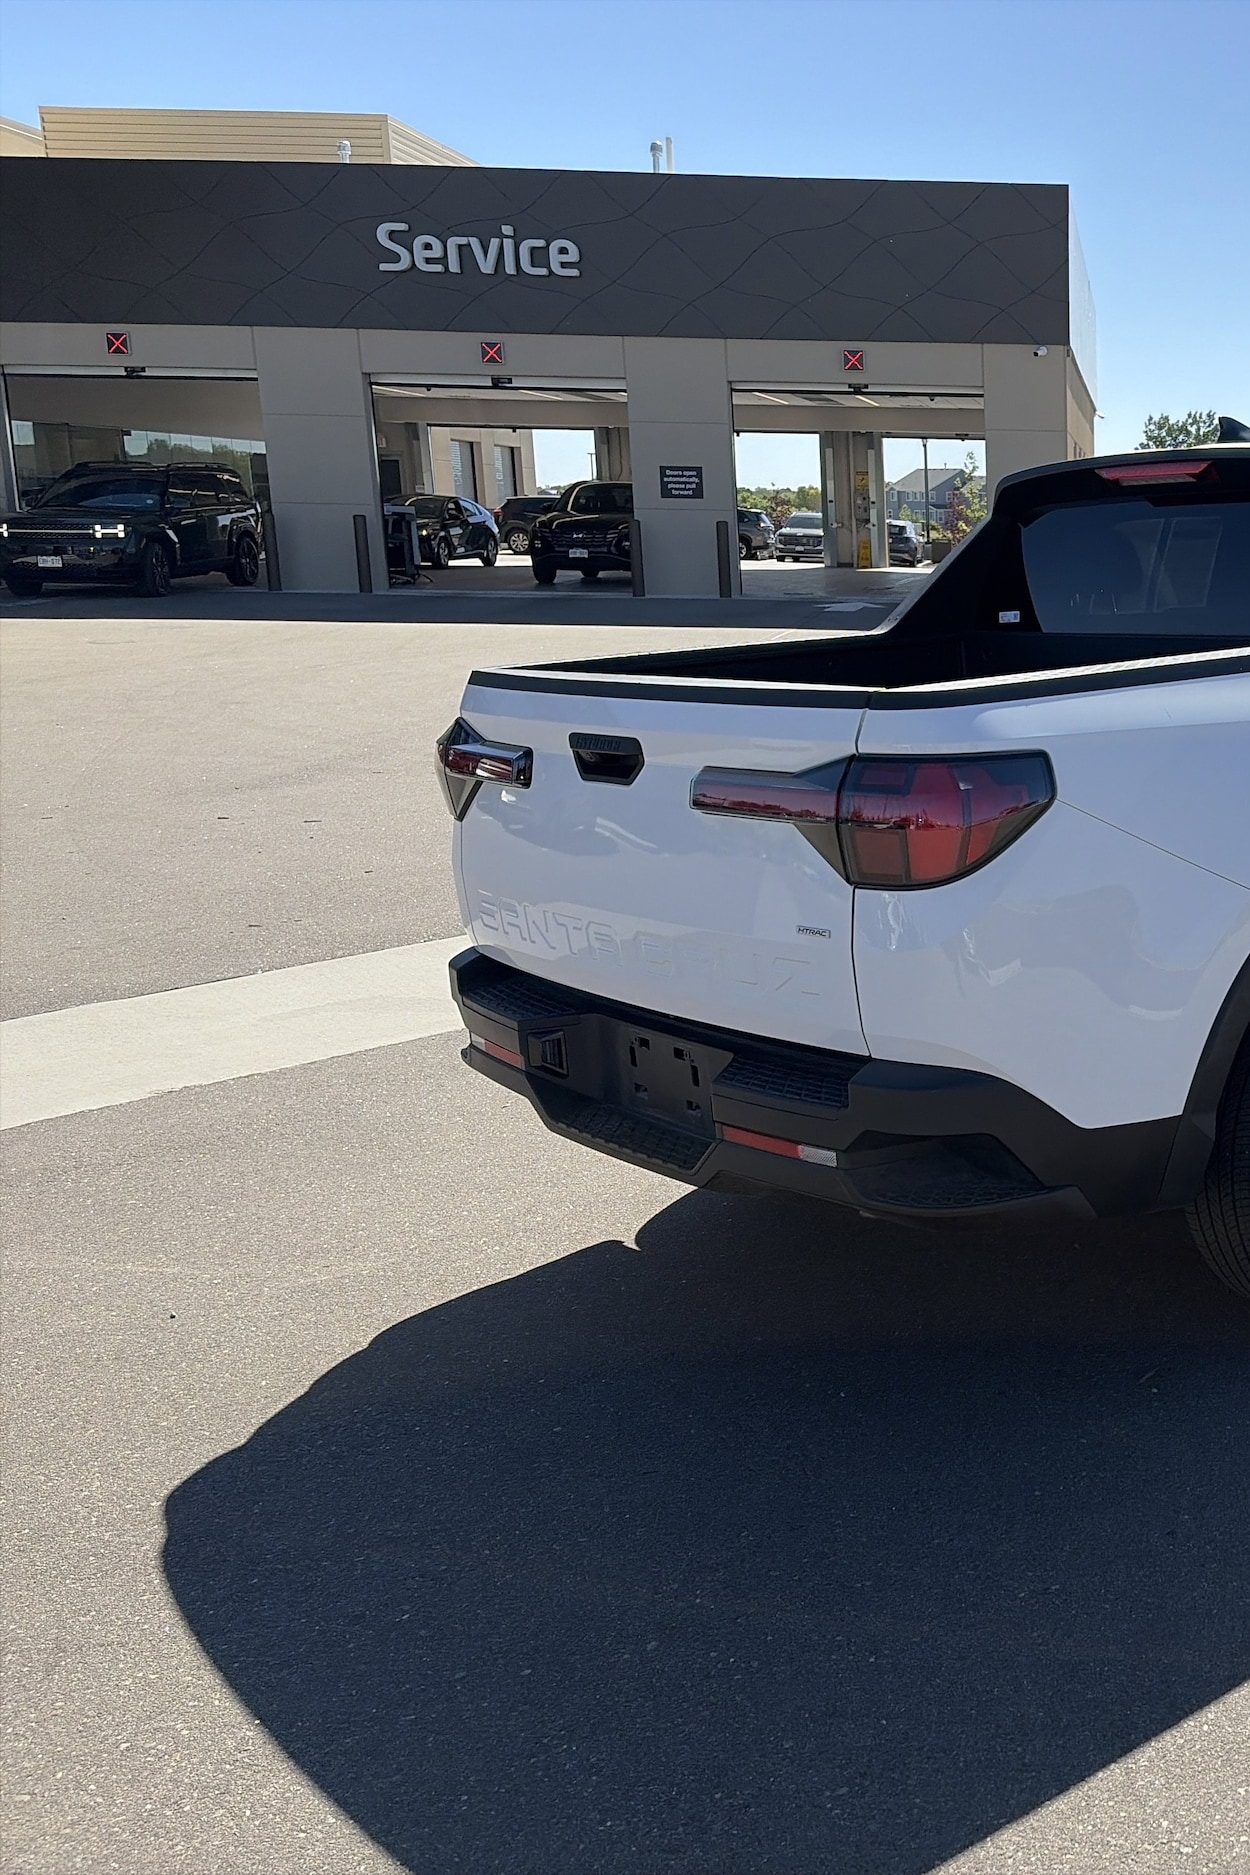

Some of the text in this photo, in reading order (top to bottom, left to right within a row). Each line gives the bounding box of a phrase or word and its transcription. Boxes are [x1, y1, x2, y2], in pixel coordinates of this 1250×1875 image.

[376, 222, 581, 277] Service
[478, 888, 623, 967] SANTA
[797, 926, 828, 937] HTRAC
